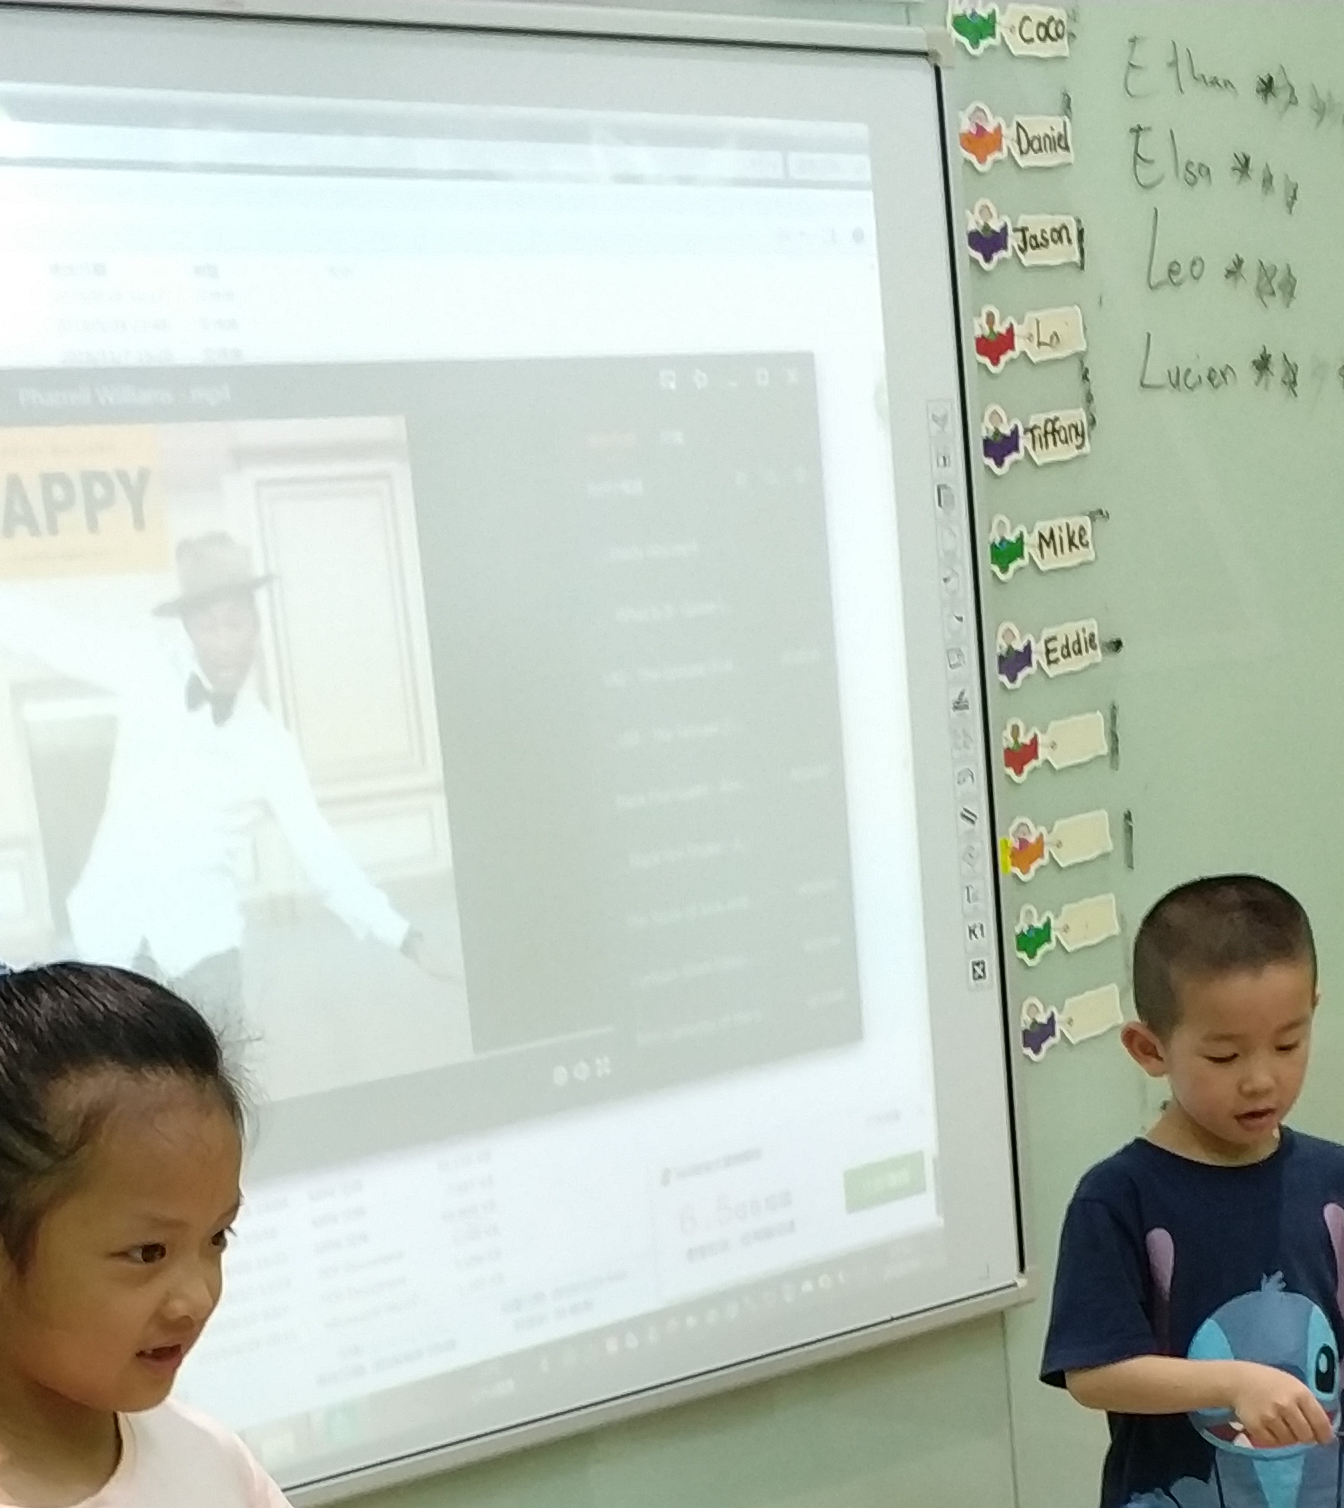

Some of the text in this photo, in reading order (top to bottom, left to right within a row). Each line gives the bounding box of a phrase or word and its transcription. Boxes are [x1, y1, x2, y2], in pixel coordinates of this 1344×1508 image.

[1123, 35, 1238, 99] Ethan
[1016, 120, 1071, 155] Daniel
[1128, 123, 1213, 190] Elsa
[1012, 222, 1072, 255] Jason
[1146, 206, 1205, 290] Leo
[1024, 414, 1086, 452] Tiffany
[1038, 521, 1090, 560] Mike
[1044, 627, 1098, 666] Eddie
